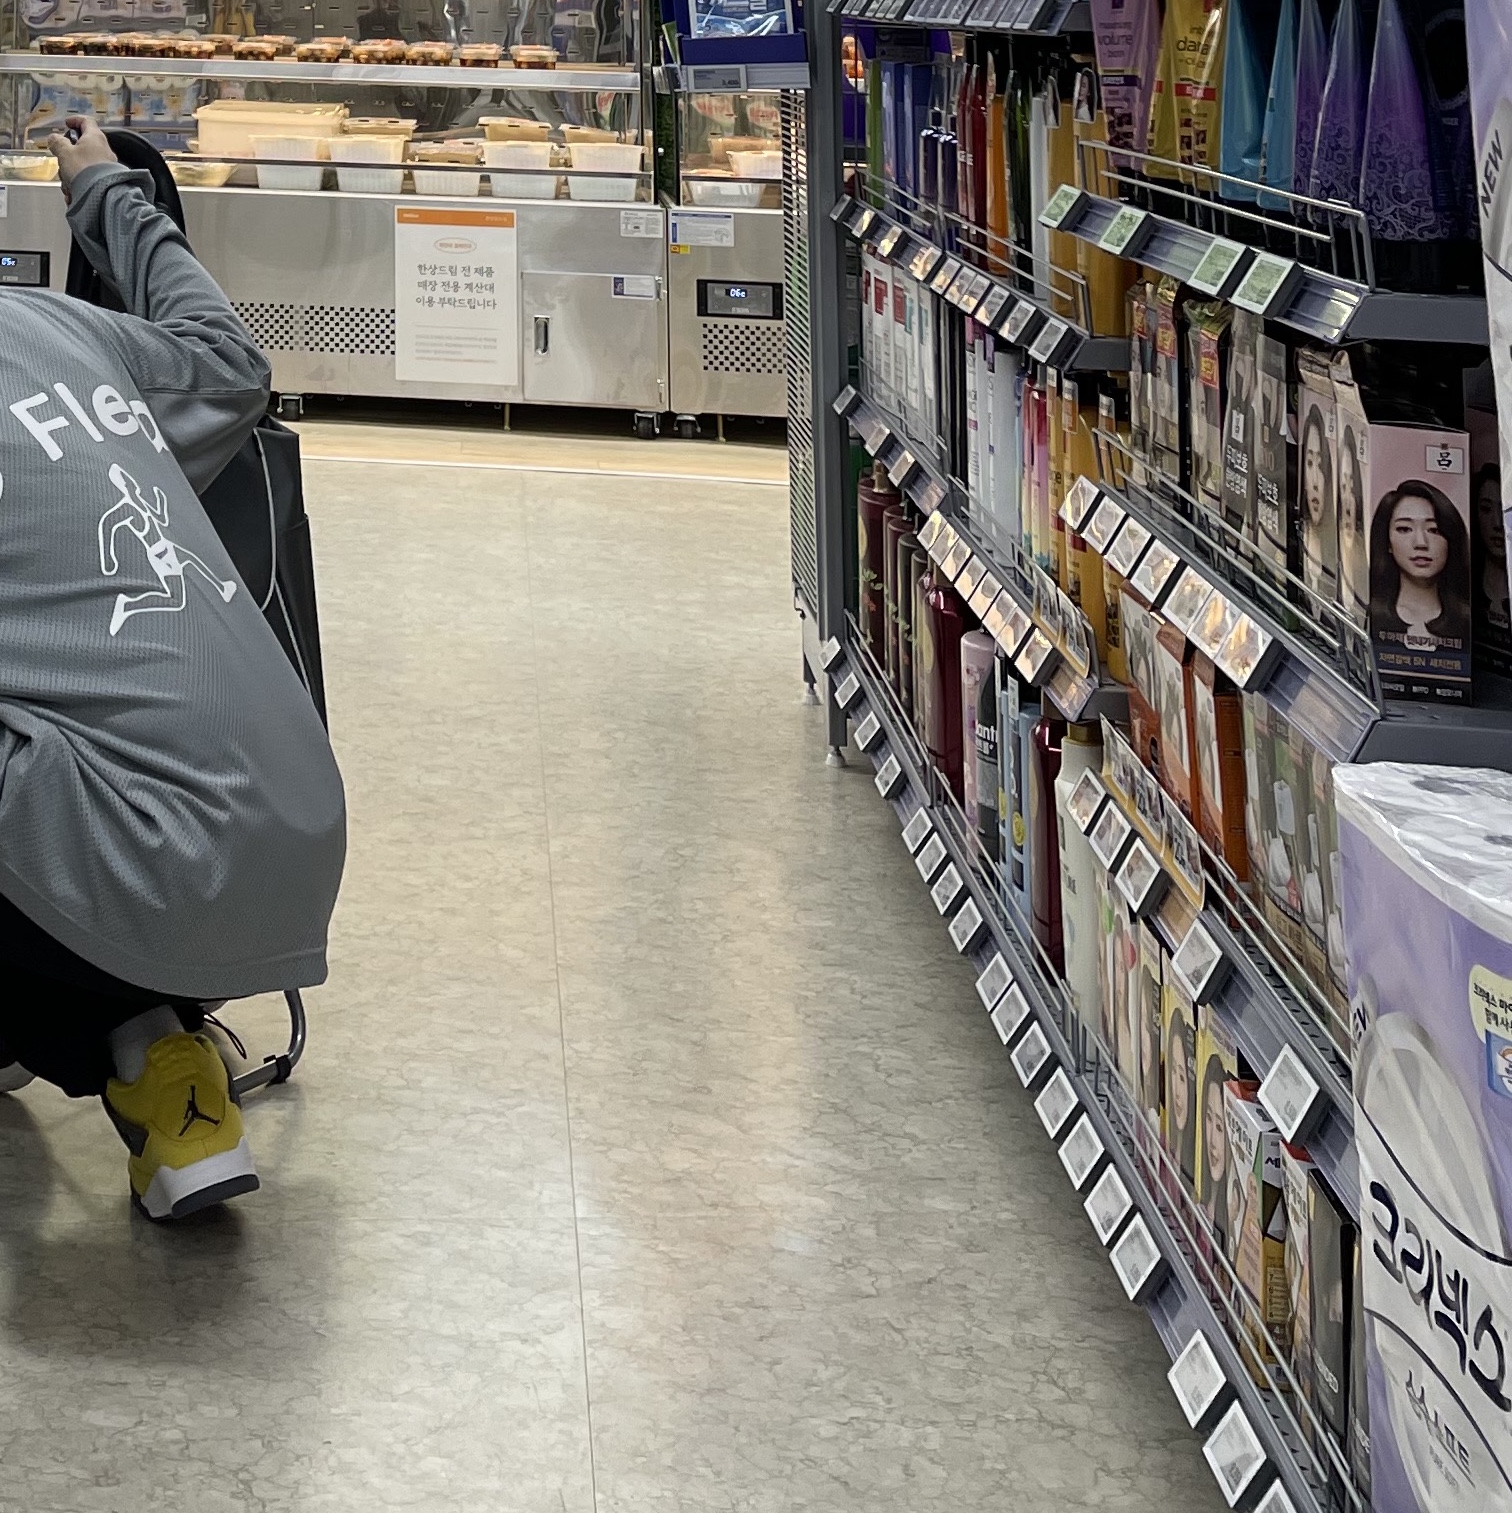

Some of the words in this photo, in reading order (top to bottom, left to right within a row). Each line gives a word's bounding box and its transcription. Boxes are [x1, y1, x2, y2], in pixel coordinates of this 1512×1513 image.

[1480, 128, 1503, 219] NEW
[461, 265, 471, 277] 전
[473, 266, 495, 278] 제품
[417, 281, 437, 293] 매장
[440, 281, 461, 293] 전용
[464, 282, 495, 294] 계산대
[415, 296, 435, 308] 이용
[437, 296, 497, 310] 부탁드립니다
